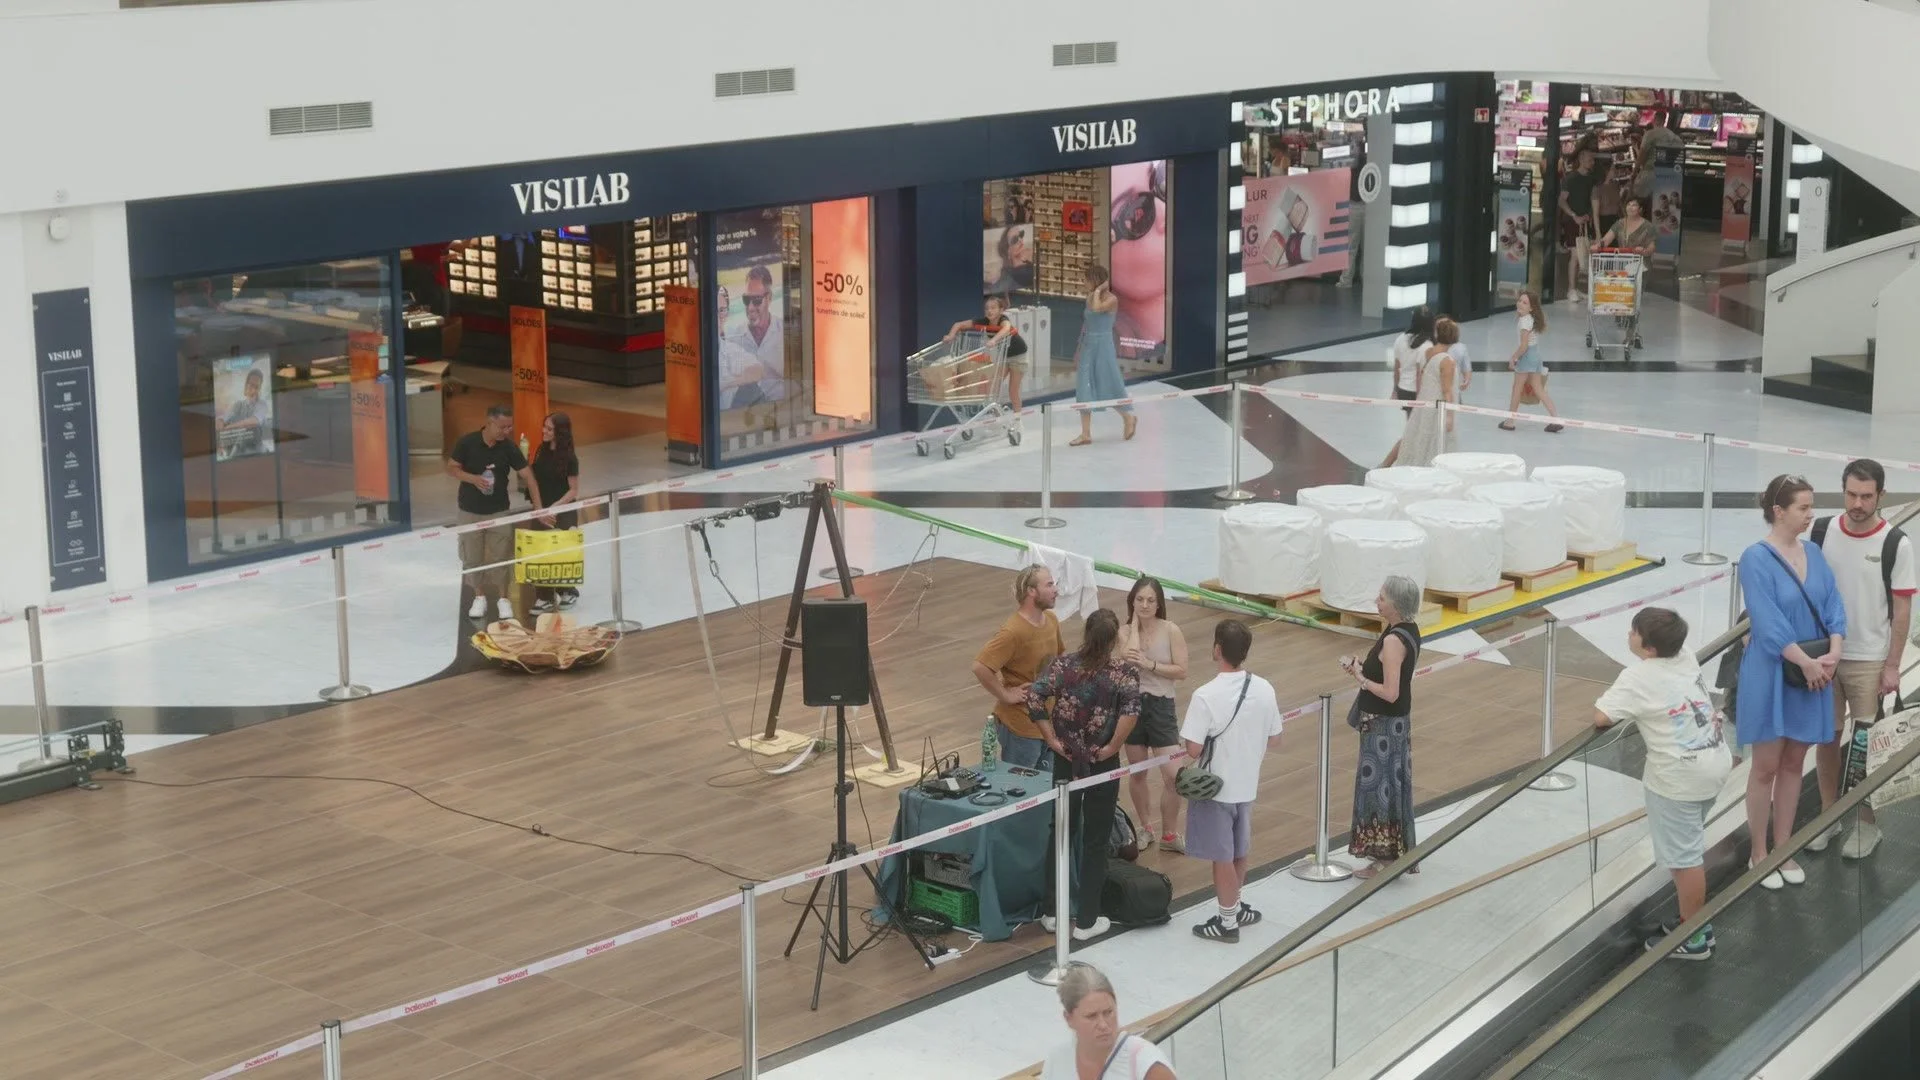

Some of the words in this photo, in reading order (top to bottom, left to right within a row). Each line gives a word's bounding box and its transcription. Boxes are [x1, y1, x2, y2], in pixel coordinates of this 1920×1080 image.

[1271, 86, 1400, 127] SEPHORA
[1052, 118, 1137, 153] VISILAB
[510, 172, 630, 215] VISILAB
[816, 272, 864, 296] -50%
[48, 349, 82, 361] VISILAB
[665, 343, 696, 357] -50%
[515, 368, 545, 384] -50%
